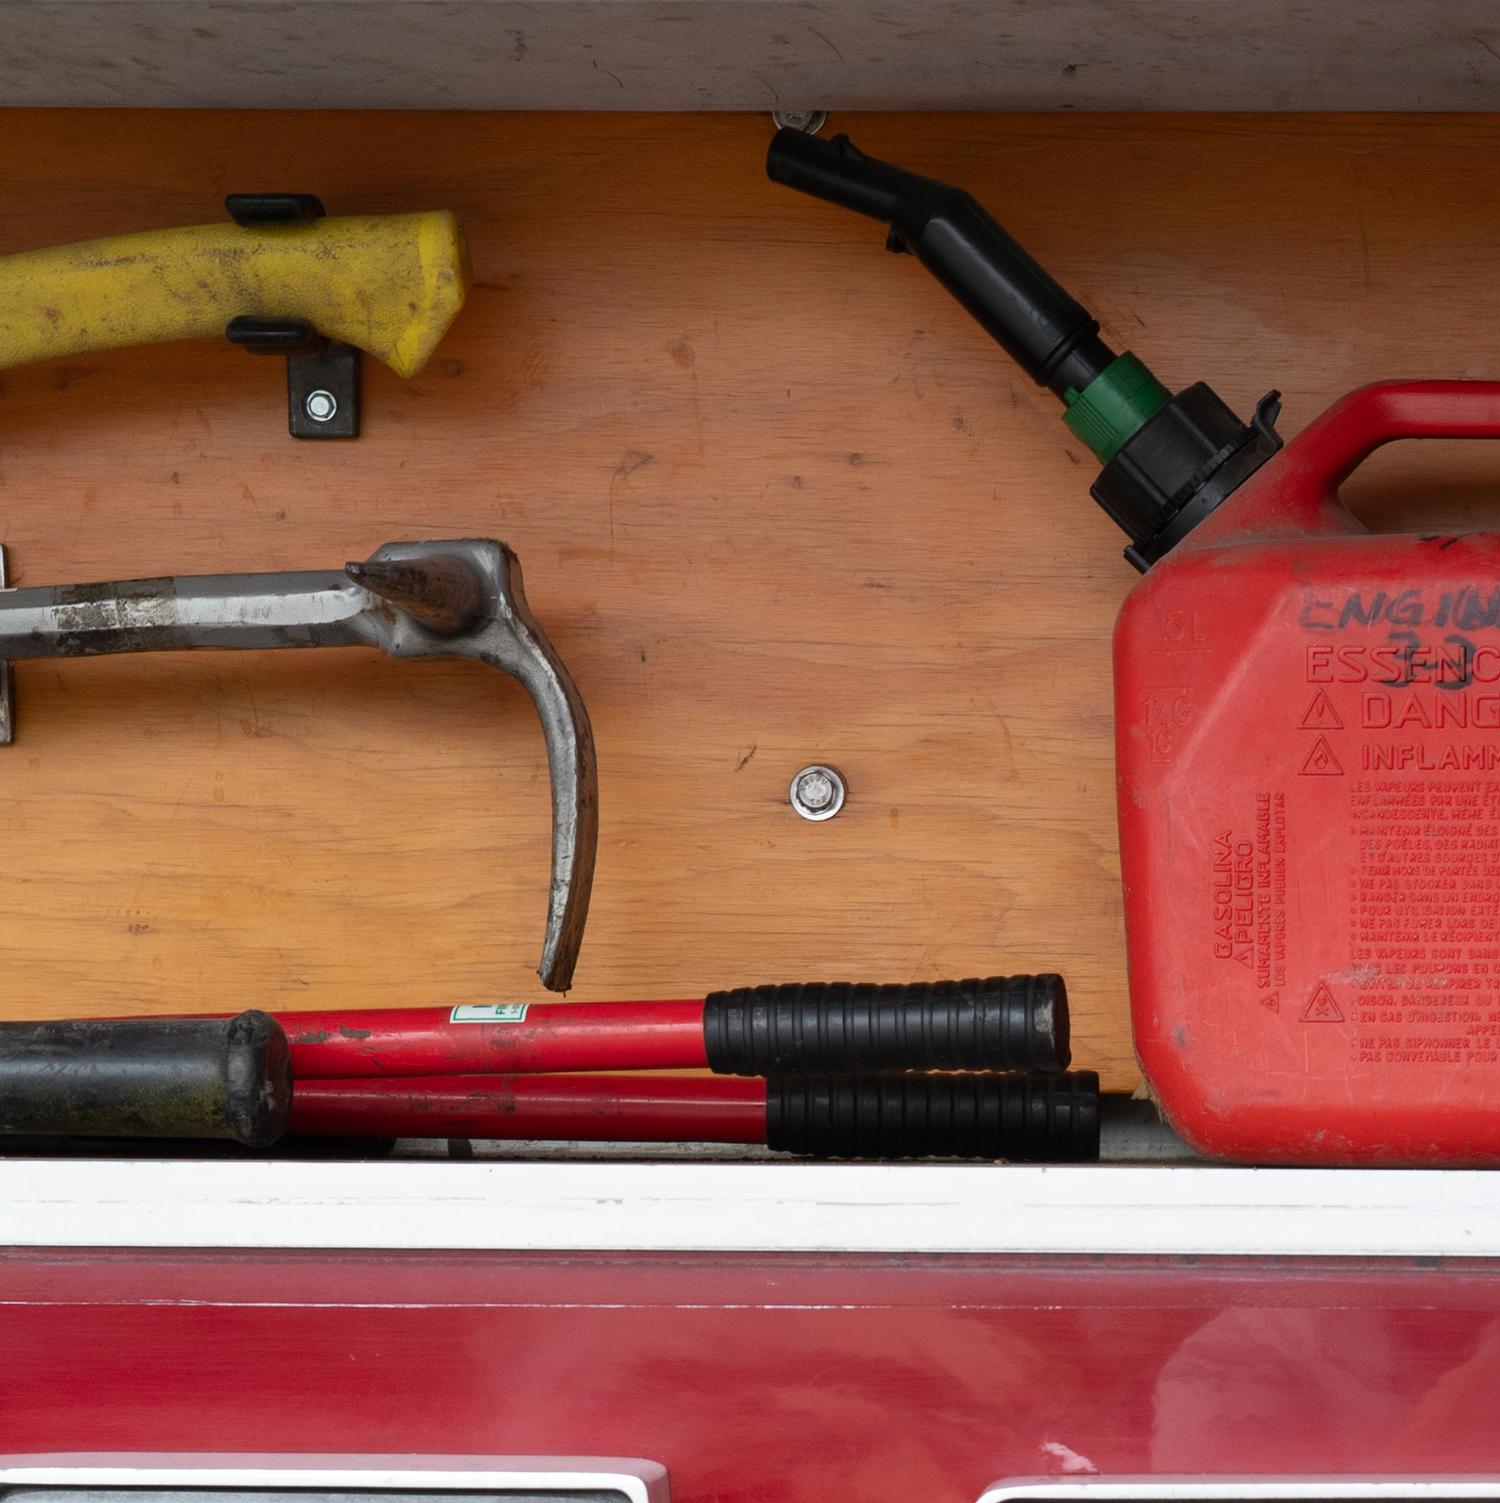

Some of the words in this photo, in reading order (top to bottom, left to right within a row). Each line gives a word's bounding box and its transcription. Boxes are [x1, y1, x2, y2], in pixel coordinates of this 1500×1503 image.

[1350, 782, 1371, 793] LES
[1375, 782, 1425, 793] VAPEURS
[1428, 782, 1481, 793] PEUVENT
[1431, 795, 1453, 807] PAR
[1456, 795, 1478, 807] UNE
[1359, 825, 1422, 837] MAINTENIR
[1476, 825, 1498, 837] DES
[1256, 792, 1271, 888] INFLAMABLE
[1360, 839, 1381, 850] DES
[1436, 839, 1458, 850] DES
[1360, 852, 1374, 863] ET
[1434, 852, 1487, 863] SOURCES
[1423, 865, 1436, 877] DE
[1484, 865, 1500, 877] DES
[1360, 879, 1375, 890] NE
[1379, 879, 1400, 890] PAS
[1405, 879, 1457, 890] STOCKER
[1462, 879, 1492, 890] DANS
[1214, 830, 1233, 959] GASOLINA
[1234, 840, 1254, 944] PELIGRO
[1444, 892, 1459, 903] UN
[1360, 905, 1392, 917] POUR
[1360, 919, 1375, 930] NE
[1379, 919, 1401, 930] PAS
[1404, 919, 1442, 930] FUMER
[1447, 919, 1476, 930] LORS
[1481, 919, 1496, 930] DE
[1256, 895, 1271, 988] SUMAMENTE
[1360, 932, 1420, 943] MAINTENIR
[1424, 932, 1438, 943] LE
[1350, 949, 1372, 960] LES
[1376, 949, 1426, 960] VAPEURS
[1431, 949, 1463, 960] SONT
[1473, 964, 1489, 976] EN
[1360, 1012, 1376, 1023] EN
[1381, 1012, 1402, 1023] CAS
[1360, 1039, 1375, 1050] NE
[1379, 1039, 1400, 1050] PAS
[1476, 1039, 1490, 1050] LE
[1360, 1051, 1382, 1063] PAS
[1467, 1051, 1497, 1063] POUR
